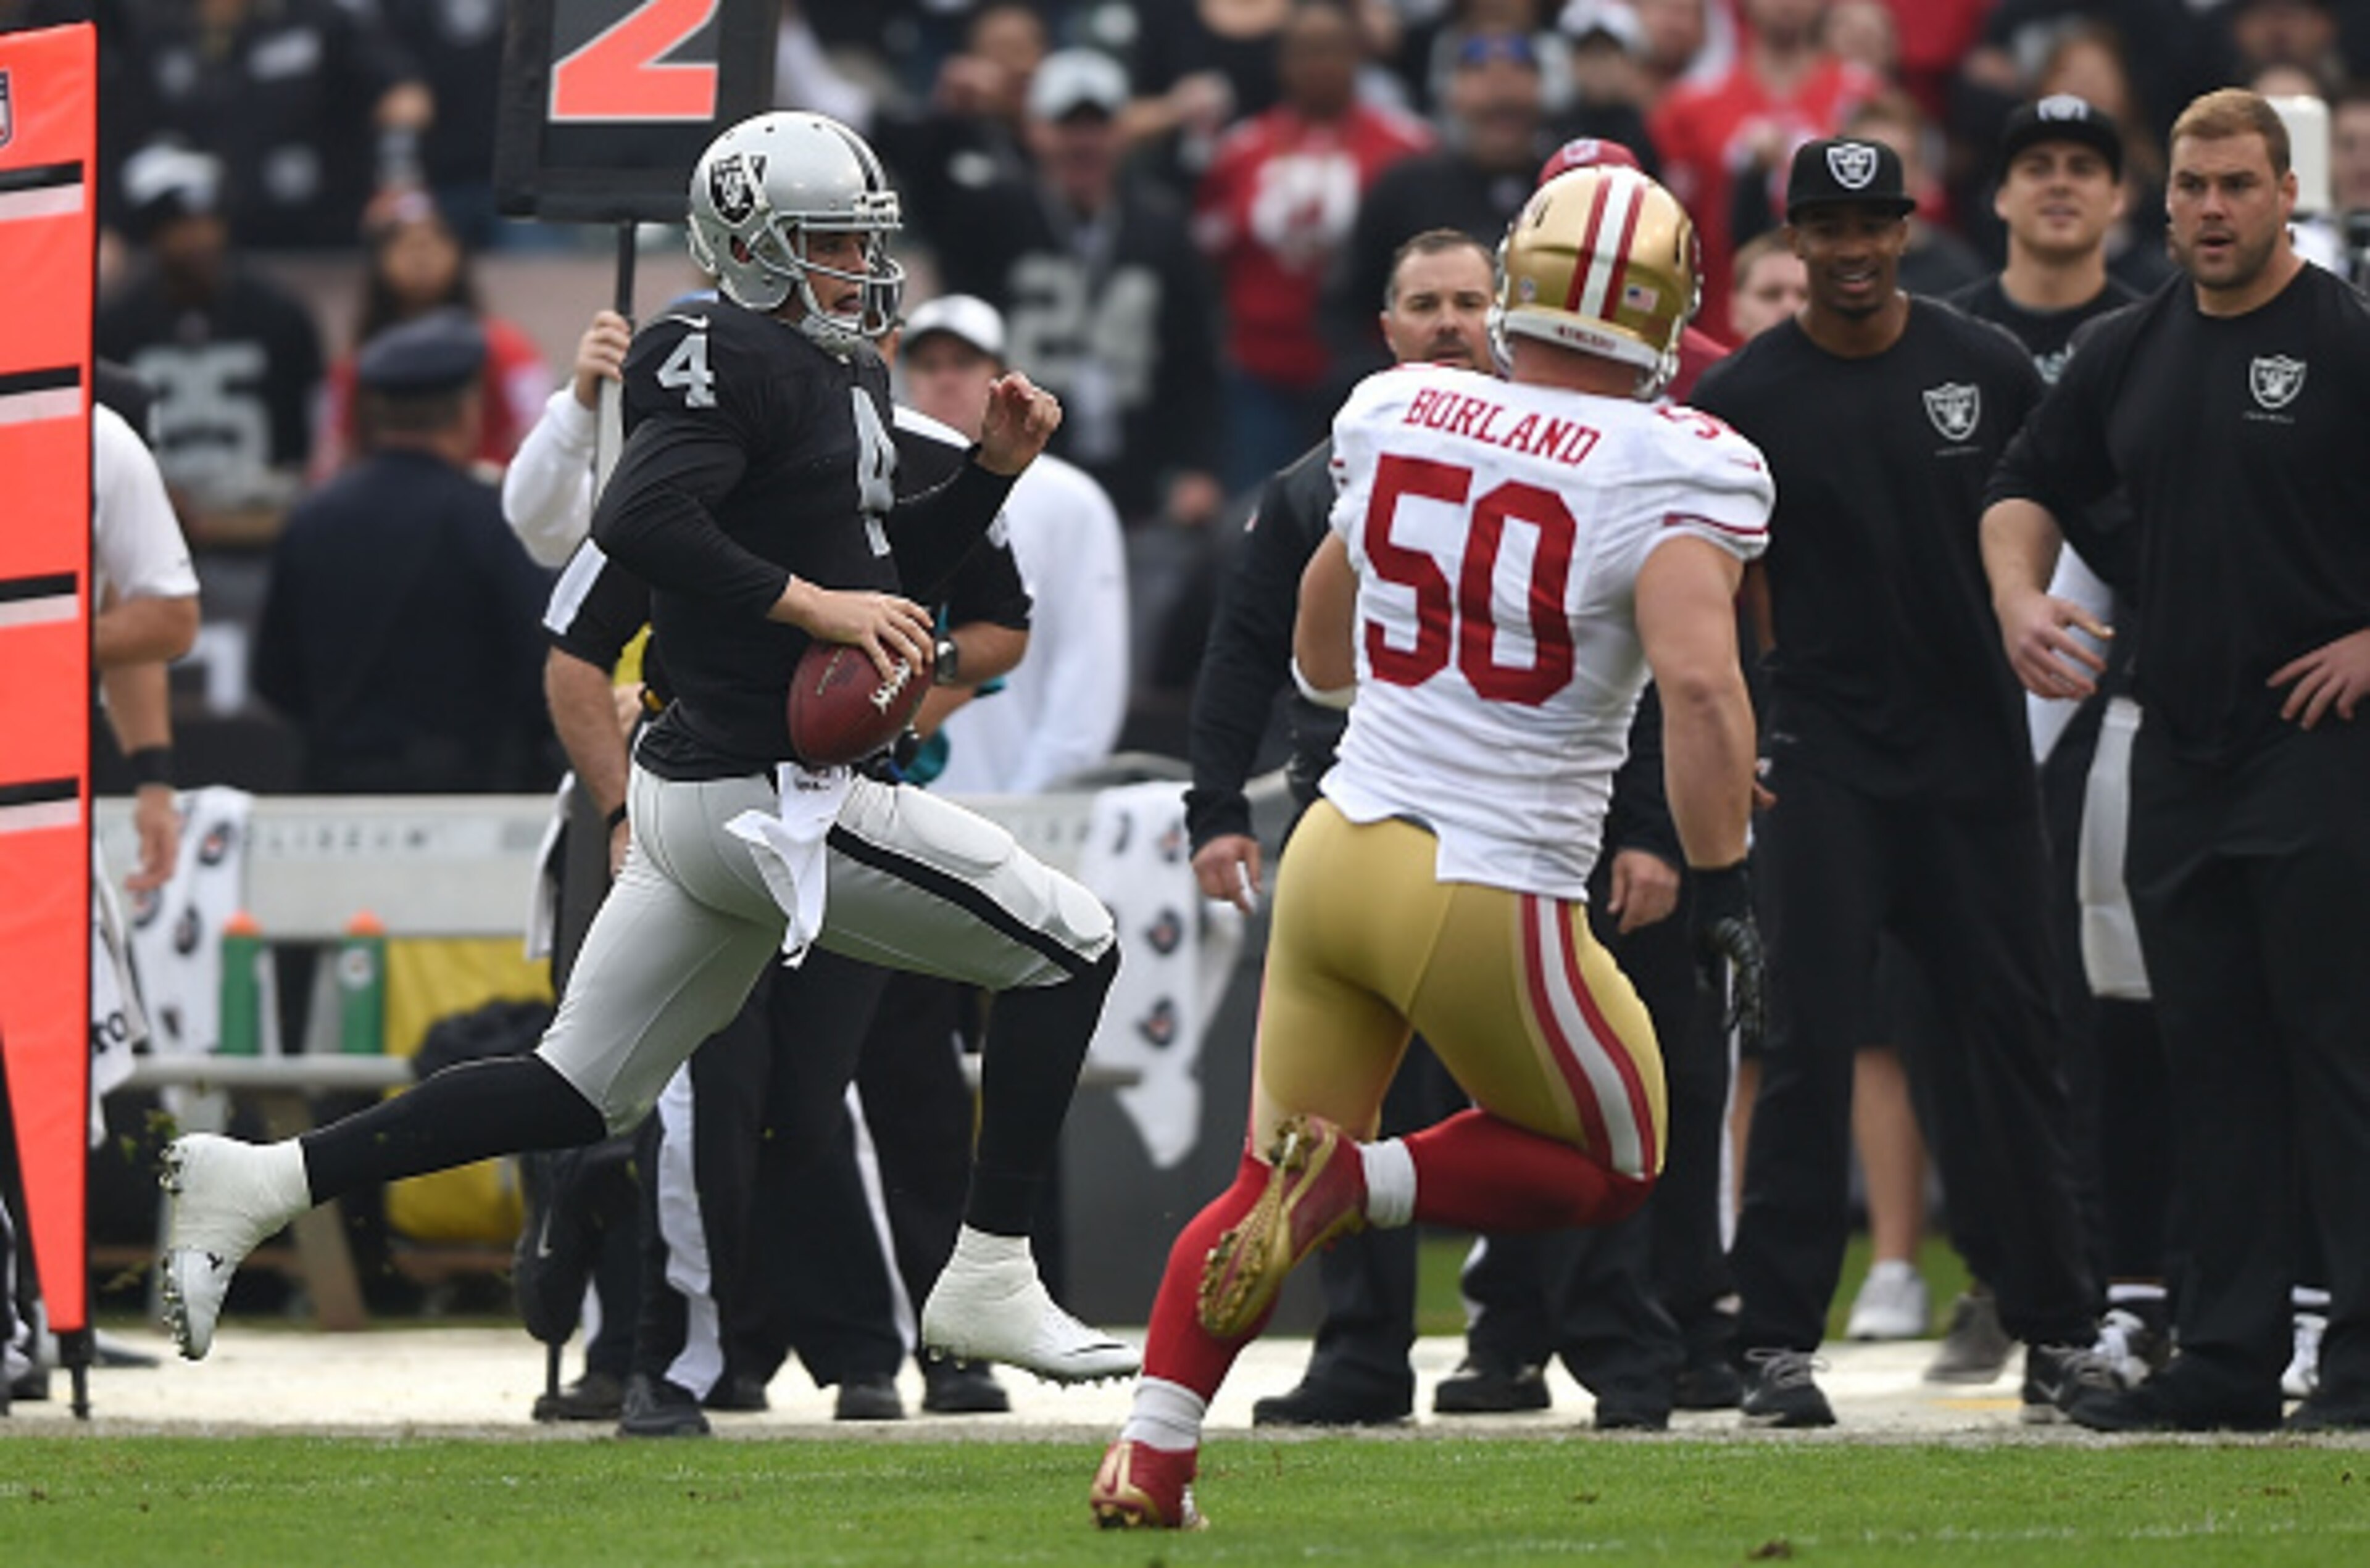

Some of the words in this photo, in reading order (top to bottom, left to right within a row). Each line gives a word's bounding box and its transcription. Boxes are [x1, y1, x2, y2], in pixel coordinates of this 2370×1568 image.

[549, 0, 718, 121] 2
[656, 333, 717, 408] 4
[1403, 388, 1601, 467] BORLAND
[850, 386, 899, 557] 4
[1364, 452, 1577, 708] 50
